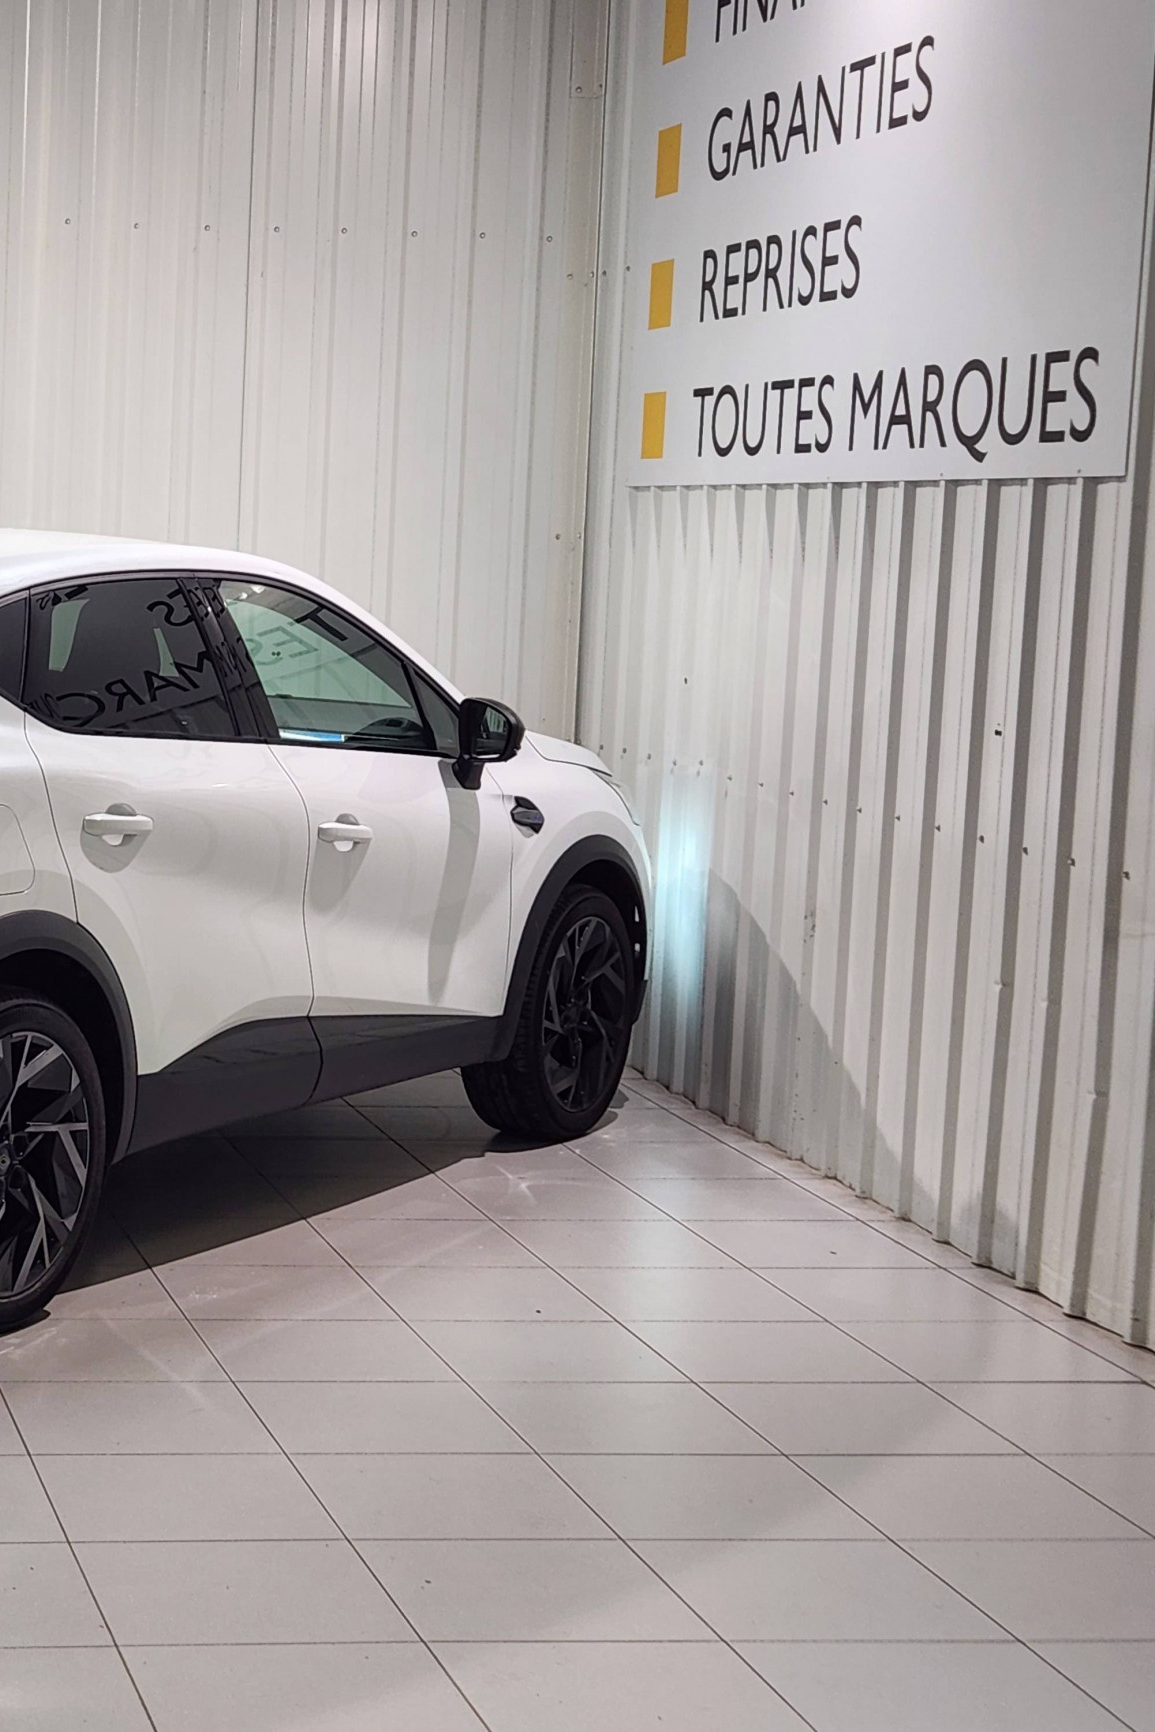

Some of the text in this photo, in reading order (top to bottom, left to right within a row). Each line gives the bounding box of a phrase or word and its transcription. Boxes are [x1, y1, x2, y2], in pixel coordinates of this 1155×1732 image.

[707, 35, 935, 181] GARANTIES
[699, 214, 863, 323] REPRISES
[692, 346, 1100, 463] TOUTES MARQUES
